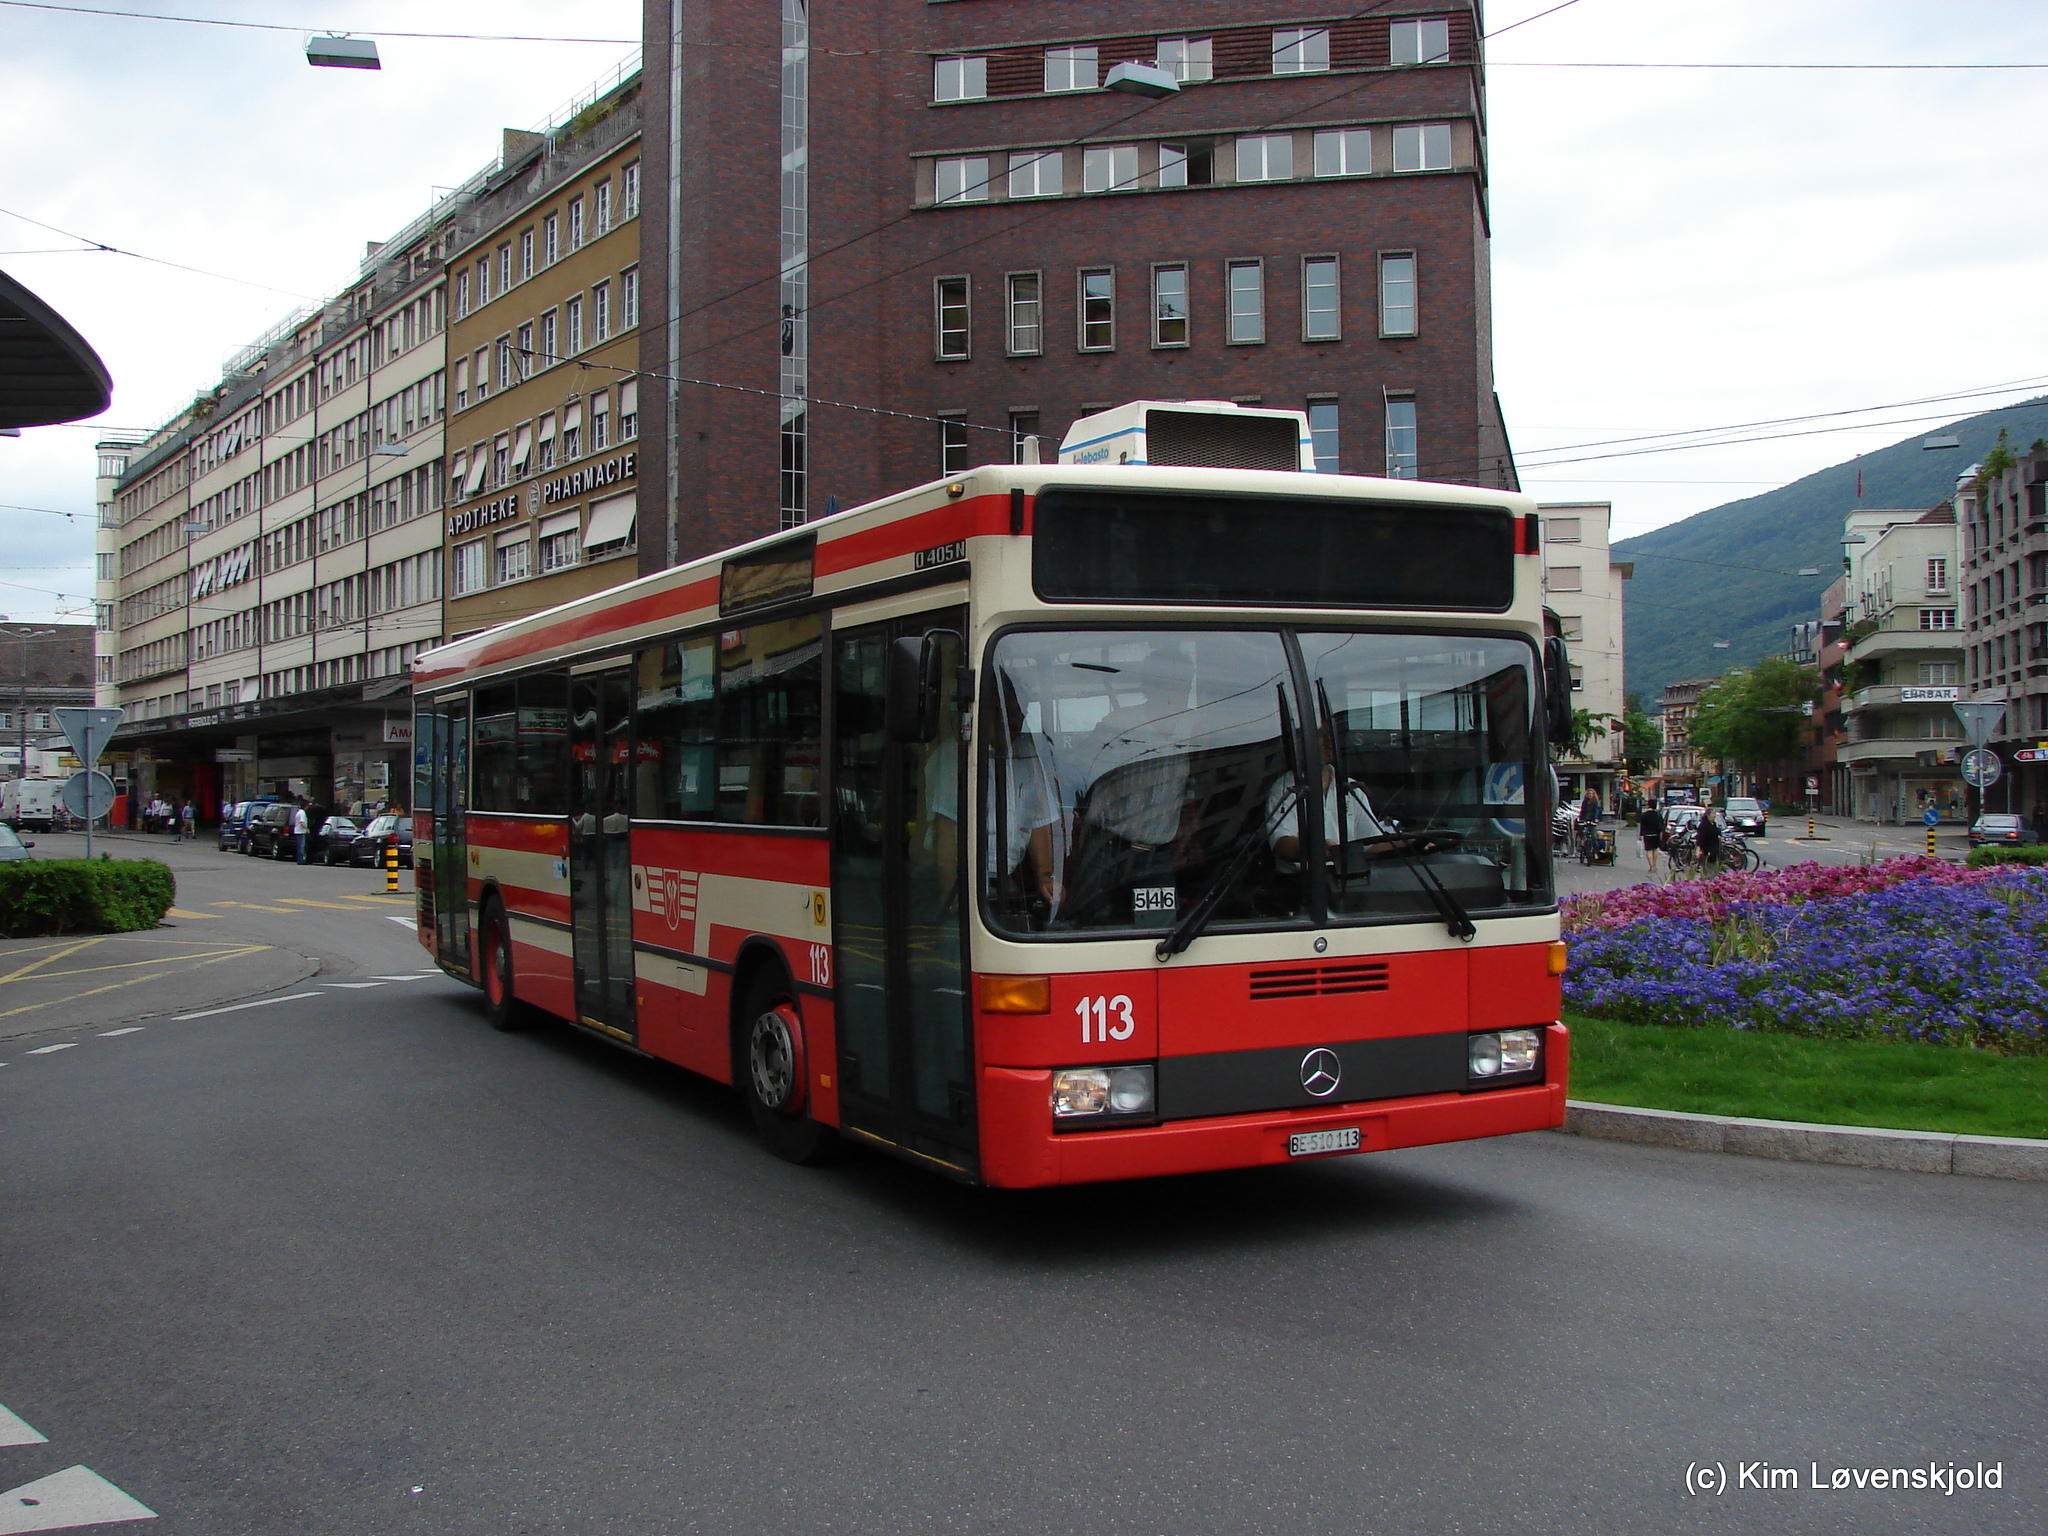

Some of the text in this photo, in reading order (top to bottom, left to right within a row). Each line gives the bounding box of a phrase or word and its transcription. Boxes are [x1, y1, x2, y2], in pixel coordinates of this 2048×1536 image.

[448, 452, 637, 536] APOTHEKE PHARMACIE
[927, 544, 954, 564] 405
[955, 540, 965, 558] N
[1135, 892, 1175, 909] 546
[810, 944, 830, 985] 113
[1075, 994, 1135, 1044] 113
